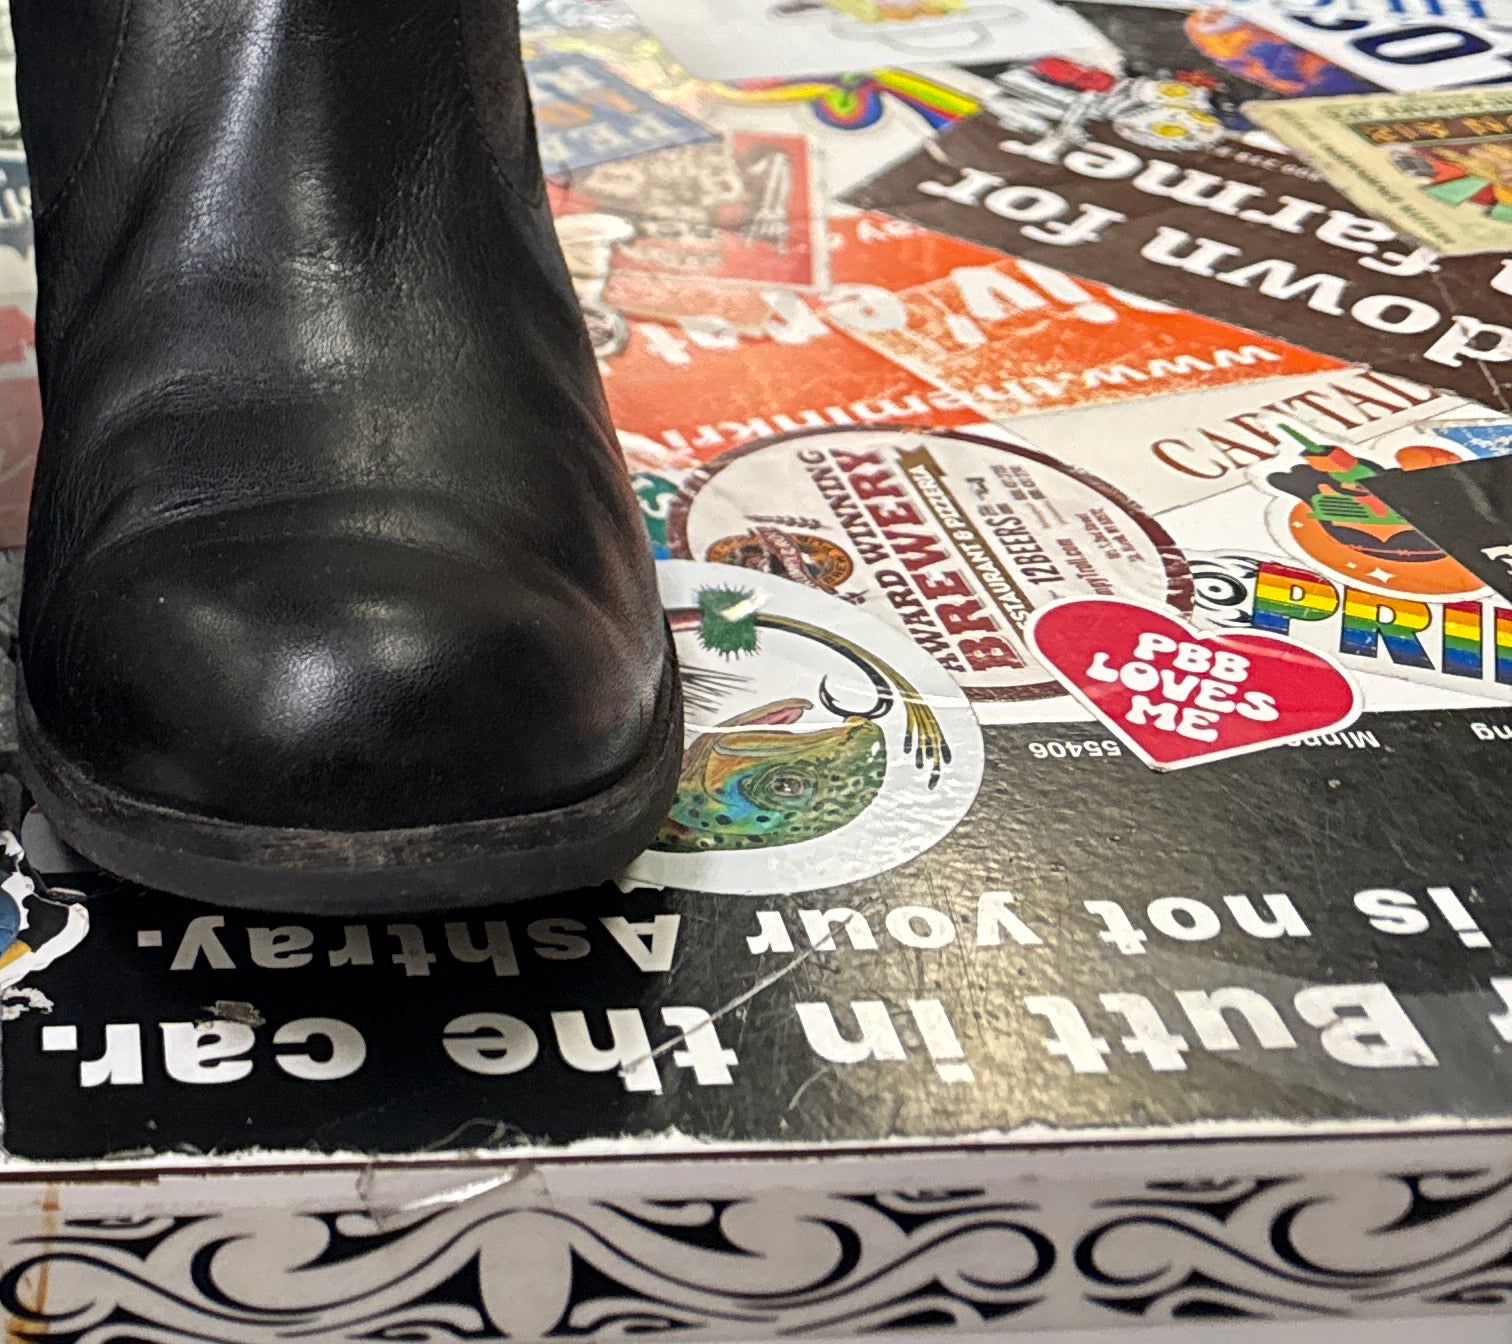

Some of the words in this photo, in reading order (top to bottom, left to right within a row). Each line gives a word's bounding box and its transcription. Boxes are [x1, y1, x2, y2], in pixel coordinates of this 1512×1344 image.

[917, 166, 1128, 247] for
[999, 137, 1441, 278] farmer
[1141, 225, 1512, 369] down
[1151, 372, 1447, 480] CAPTAL
[797, 449, 890, 565] WINNING
[828, 448, 1026, 672] BREWERY
[961, 544, 1033, 626] STAURANT
[1133, 631, 1250, 683] PBB
[1251, 562, 1512, 684] PRI
[1086, 655, 1279, 723] LOVES
[1123, 697, 1220, 744] ME
[1029, 736, 1123, 763] 55406
[134, 911, 681, 979] Ashtray.
[746, 890, 1043, 955] your
[1088, 893, 1313, 956] not
[1352, 886, 1493, 949] is
[40, 1014, 368, 1088] car.
[443, 1004, 740, 1095] the
[796, 998, 976, 1083] in
[1034, 980, 1441, 1073] Butt
